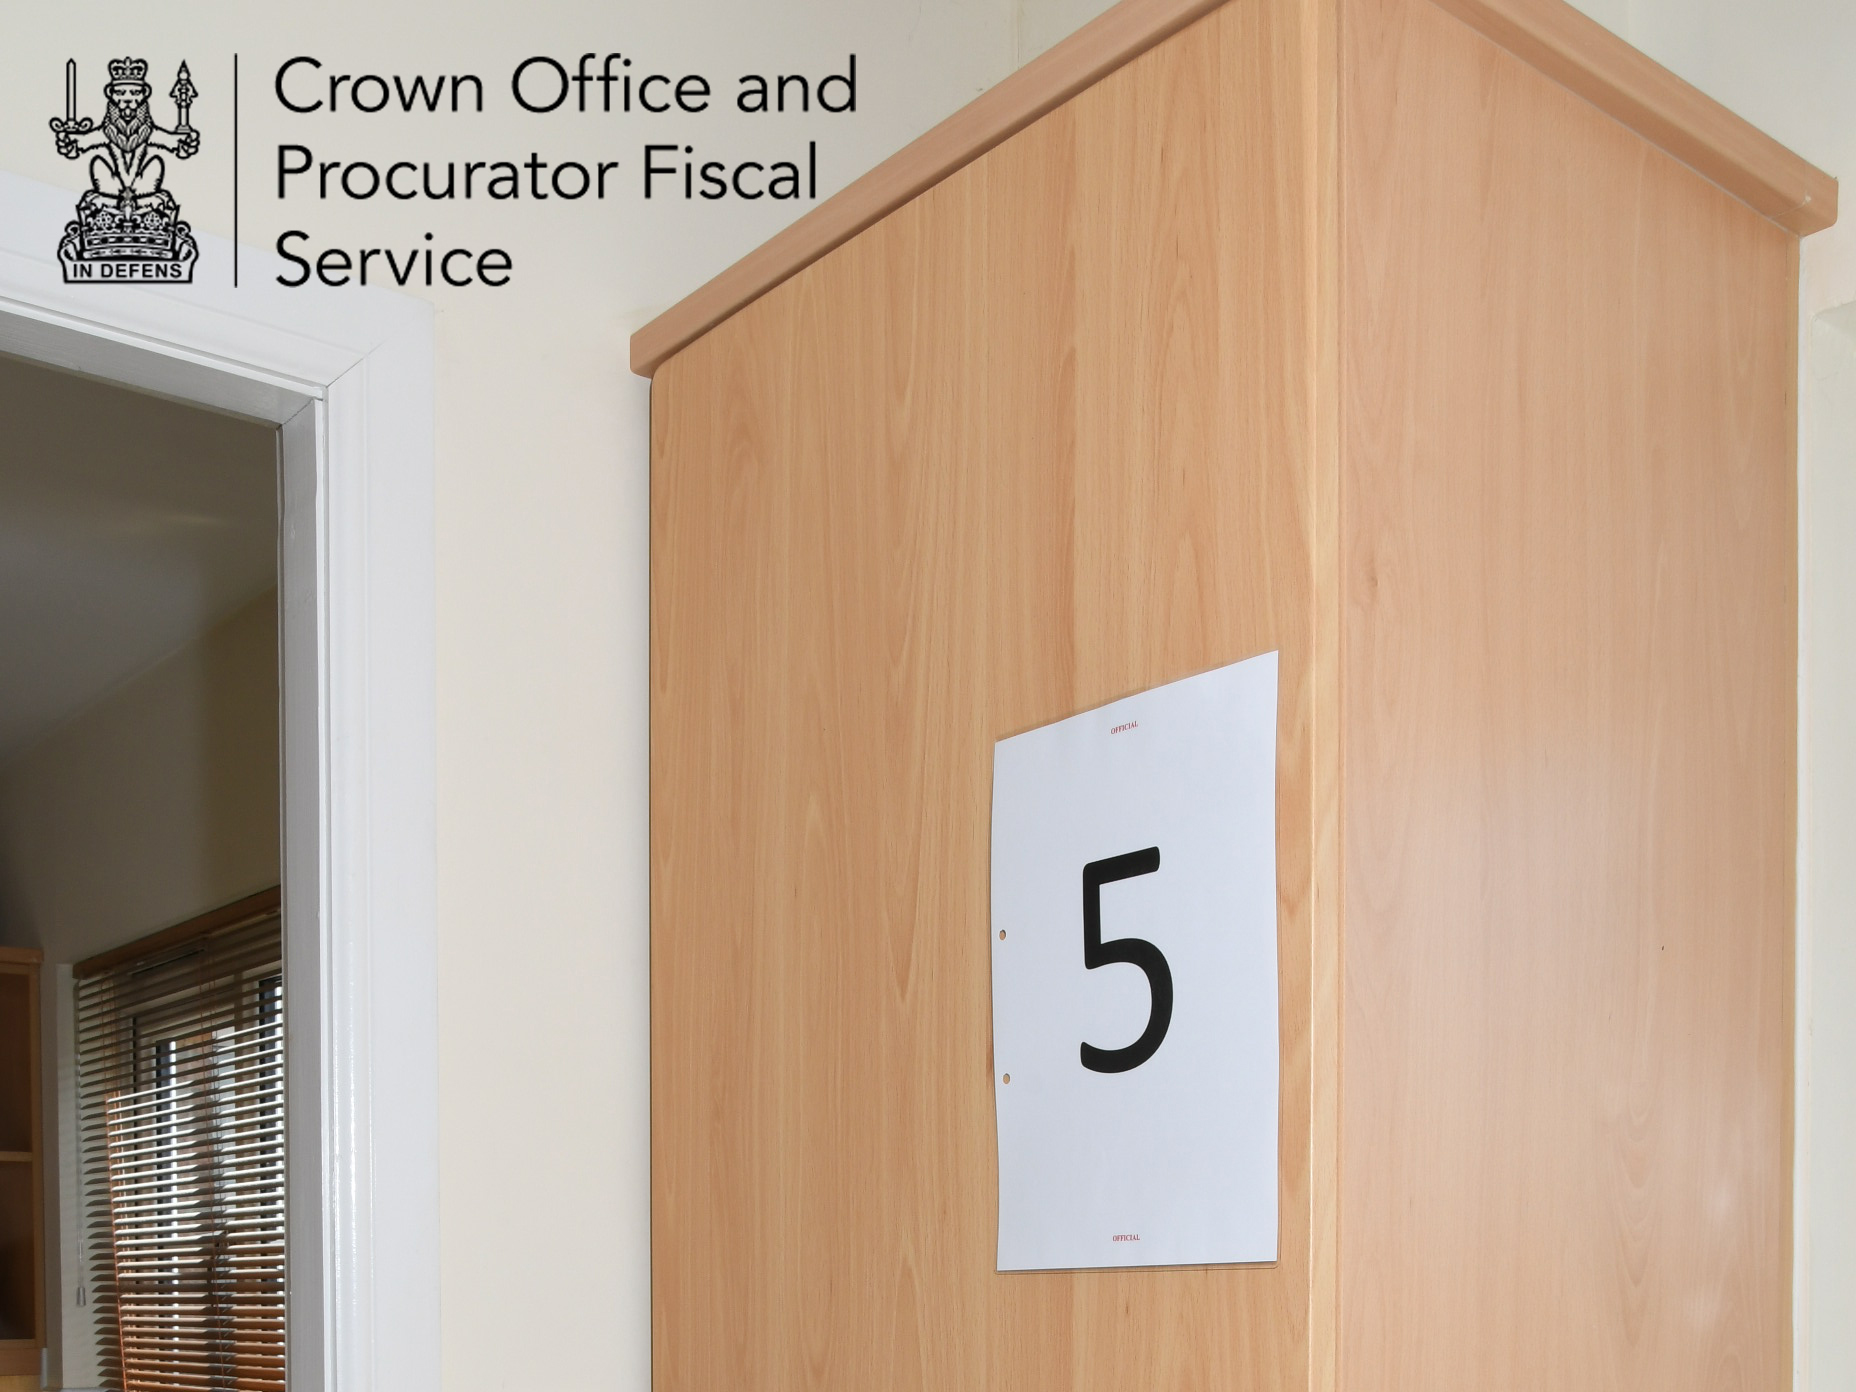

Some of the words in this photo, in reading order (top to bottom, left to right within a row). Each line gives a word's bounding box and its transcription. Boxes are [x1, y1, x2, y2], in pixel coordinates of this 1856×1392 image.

[1110, 720, 1138, 735] OFFICIAL
[1080, 847, 1173, 1073] 5
[1112, 1234, 1140, 1242] OFFICIAL
